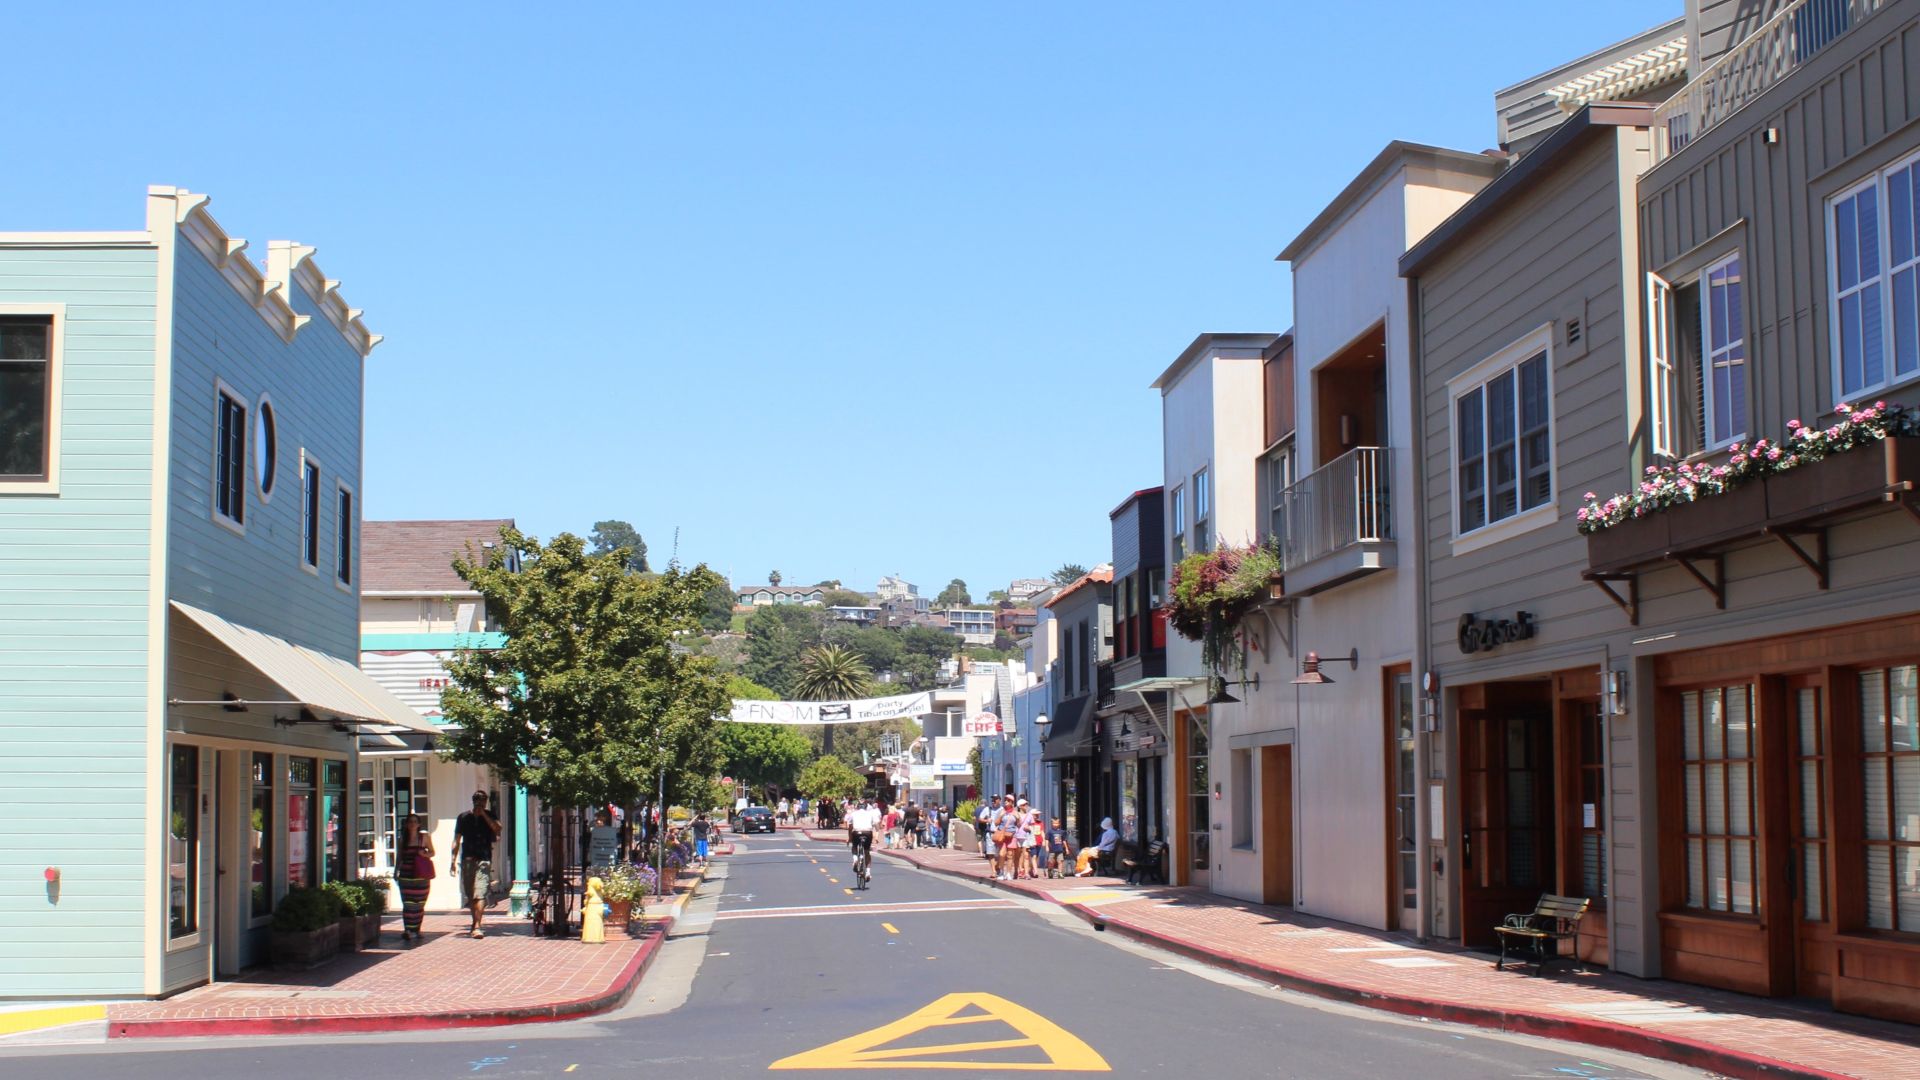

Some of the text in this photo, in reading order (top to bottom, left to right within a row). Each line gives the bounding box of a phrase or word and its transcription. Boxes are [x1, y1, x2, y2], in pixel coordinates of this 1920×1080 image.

[877, 700, 903, 709] party
[858, 709, 895, 718] Tiburon
[965, 721, 1003, 733] CAFE
